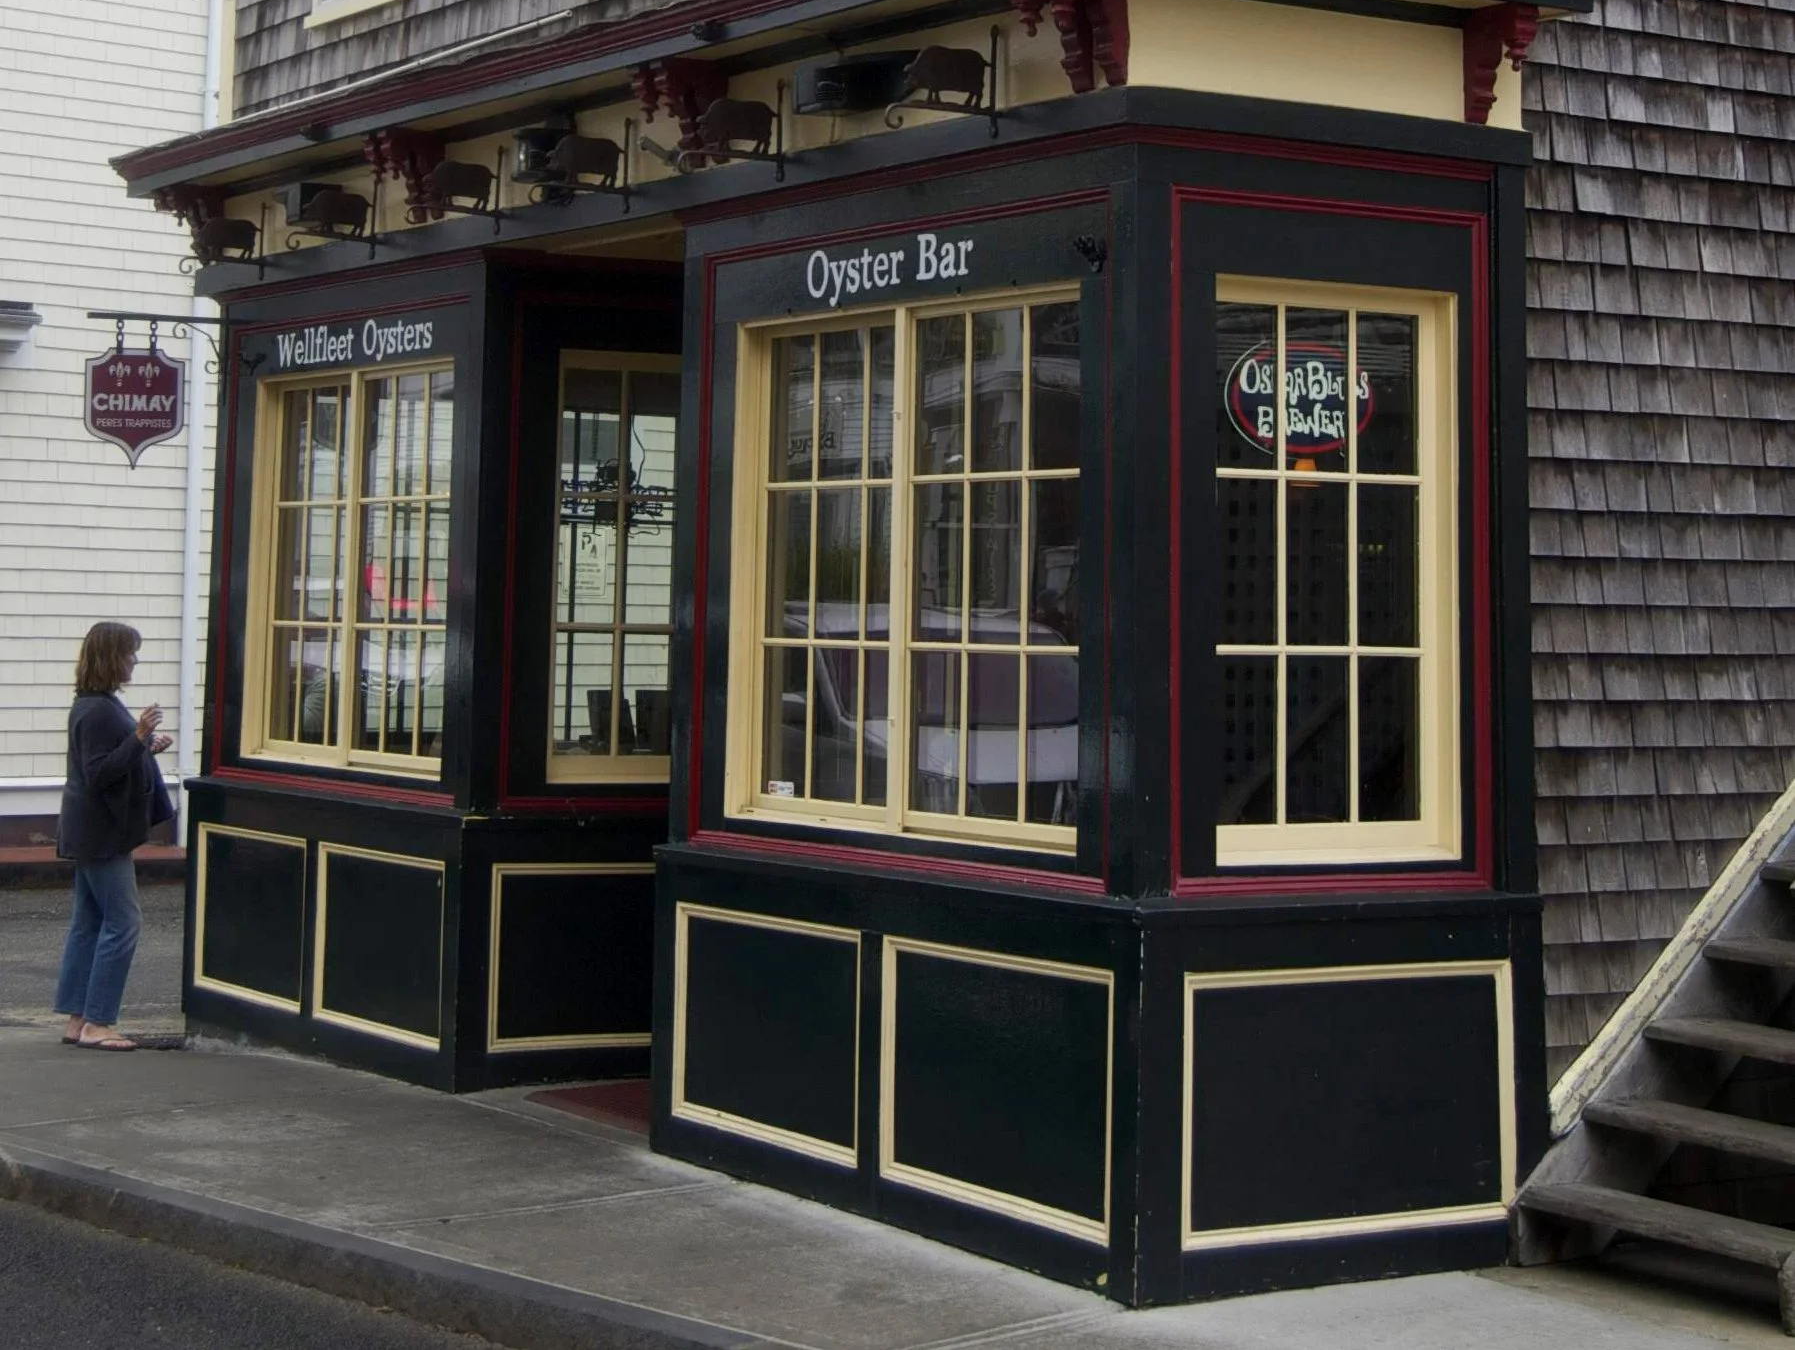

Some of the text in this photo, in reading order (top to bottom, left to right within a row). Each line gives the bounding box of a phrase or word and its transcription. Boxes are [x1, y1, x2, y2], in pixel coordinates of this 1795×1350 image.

[807, 233, 974, 308] Oyster Bar
[277, 318, 433, 368] Wellfleet Oysters
[92, 393, 176, 412] CHIMAY
[124, 418, 172, 428] TRAPPISTES
